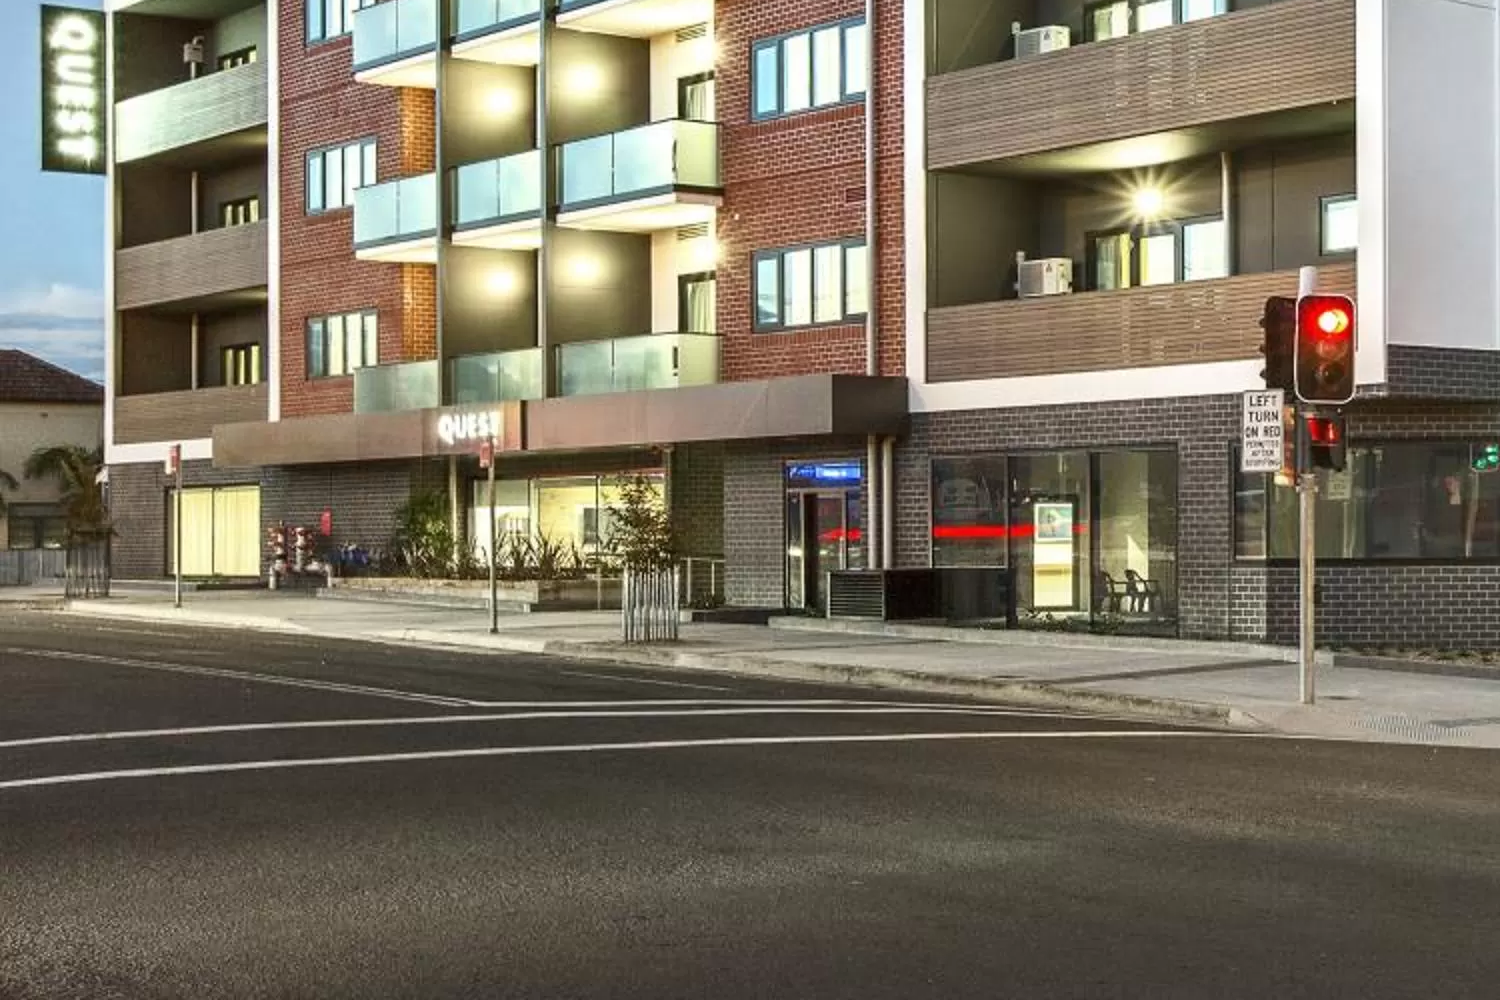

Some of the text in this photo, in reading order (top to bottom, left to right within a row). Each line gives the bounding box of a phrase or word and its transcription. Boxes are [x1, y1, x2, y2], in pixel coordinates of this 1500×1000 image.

[50, 16, 96, 162] QUEST
[1249, 395, 1277, 407] LEFT
[1248, 410, 1279, 423] TURN
[438, 409, 503, 446] QUEST
[1245, 425, 1281, 438] ON RED
